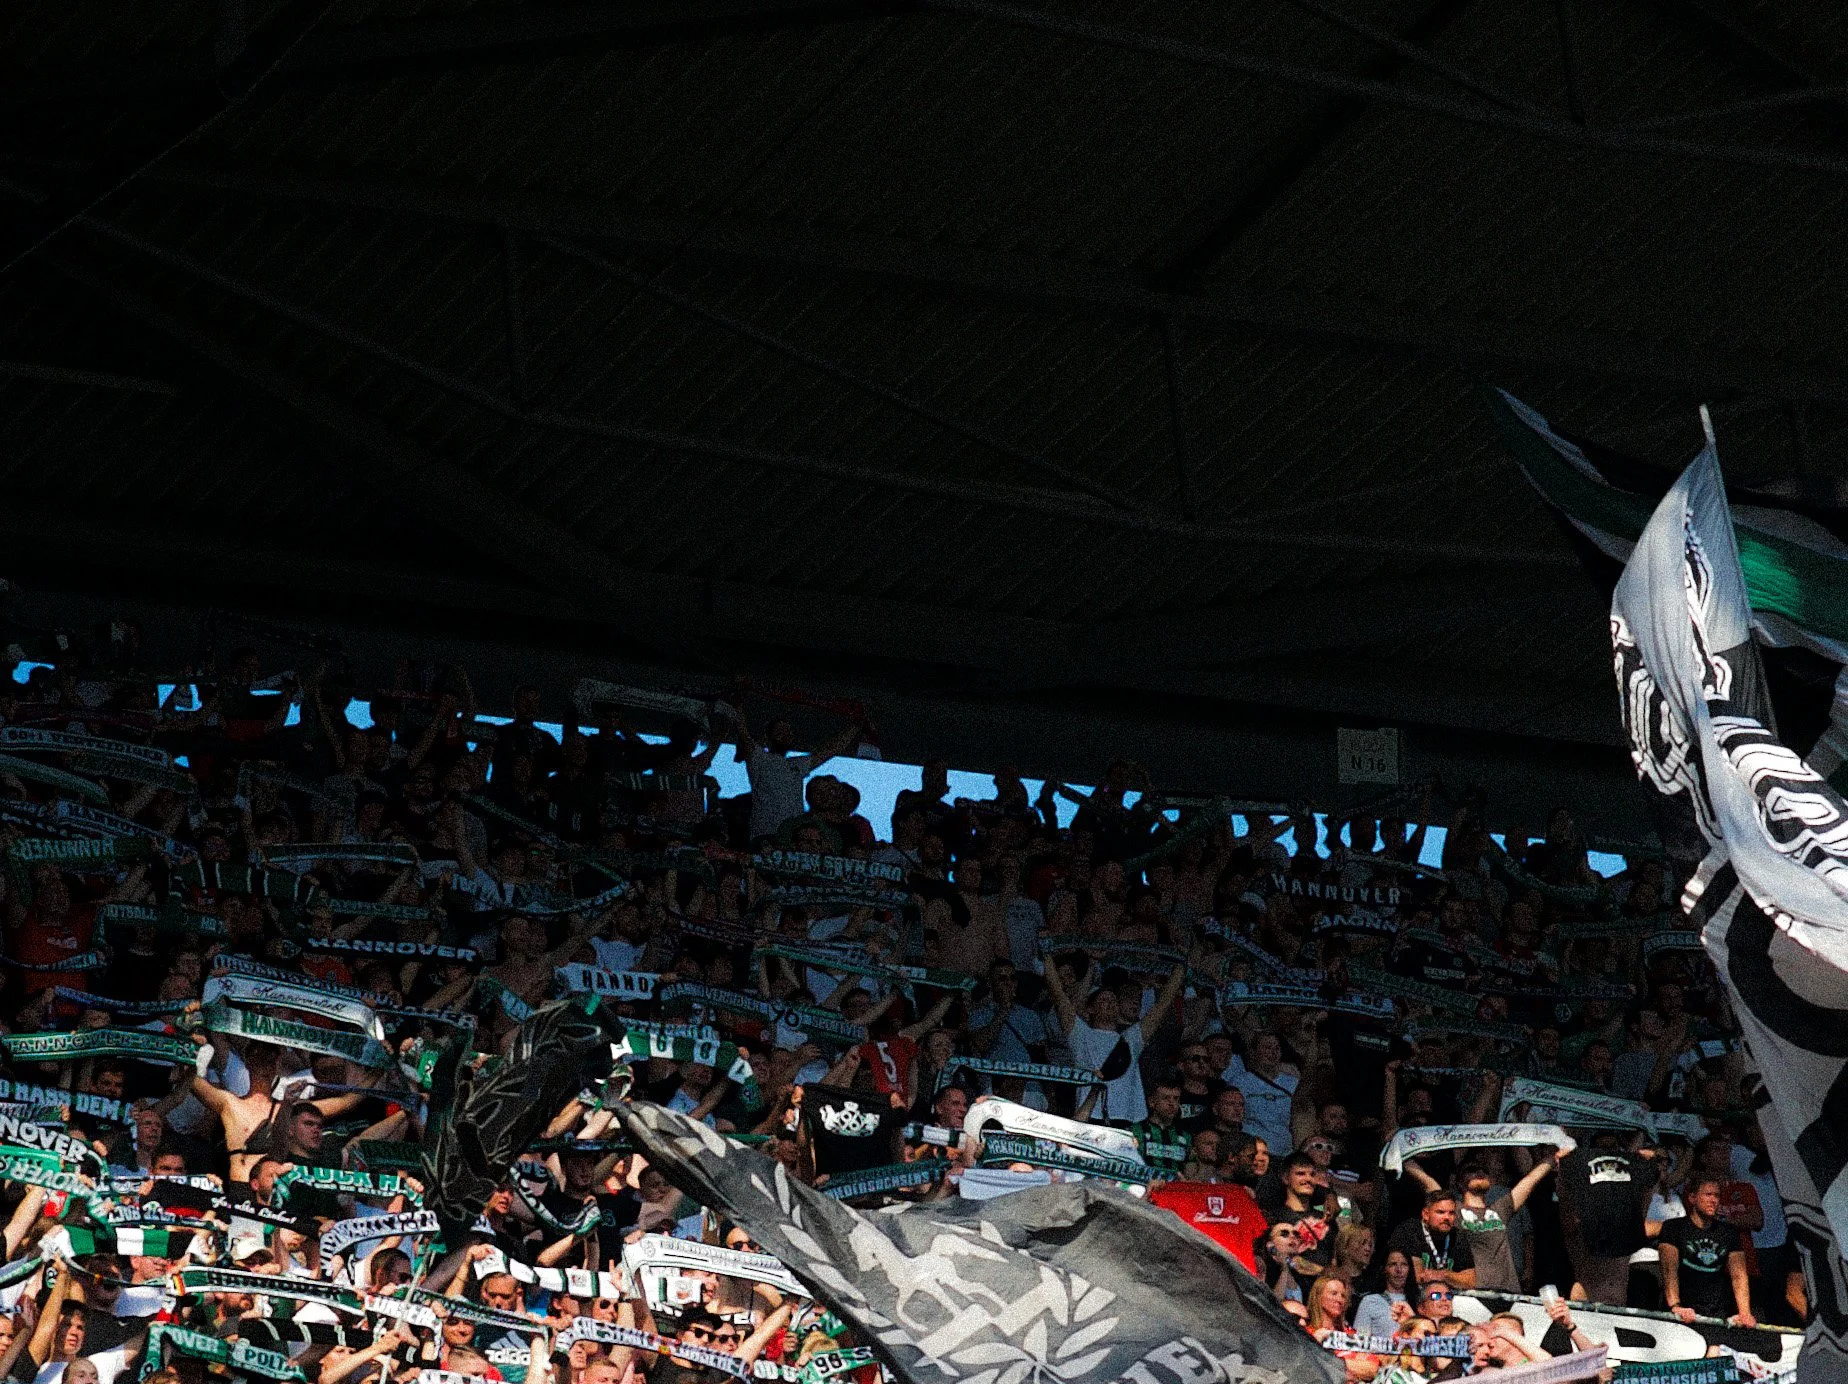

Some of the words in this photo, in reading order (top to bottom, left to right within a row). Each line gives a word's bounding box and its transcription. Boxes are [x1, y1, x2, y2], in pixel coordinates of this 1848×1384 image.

[1369, 757, 1386, 772] 16
[308, 936, 478, 962] HANNOVER
[880, 1041, 898, 1084] 5
